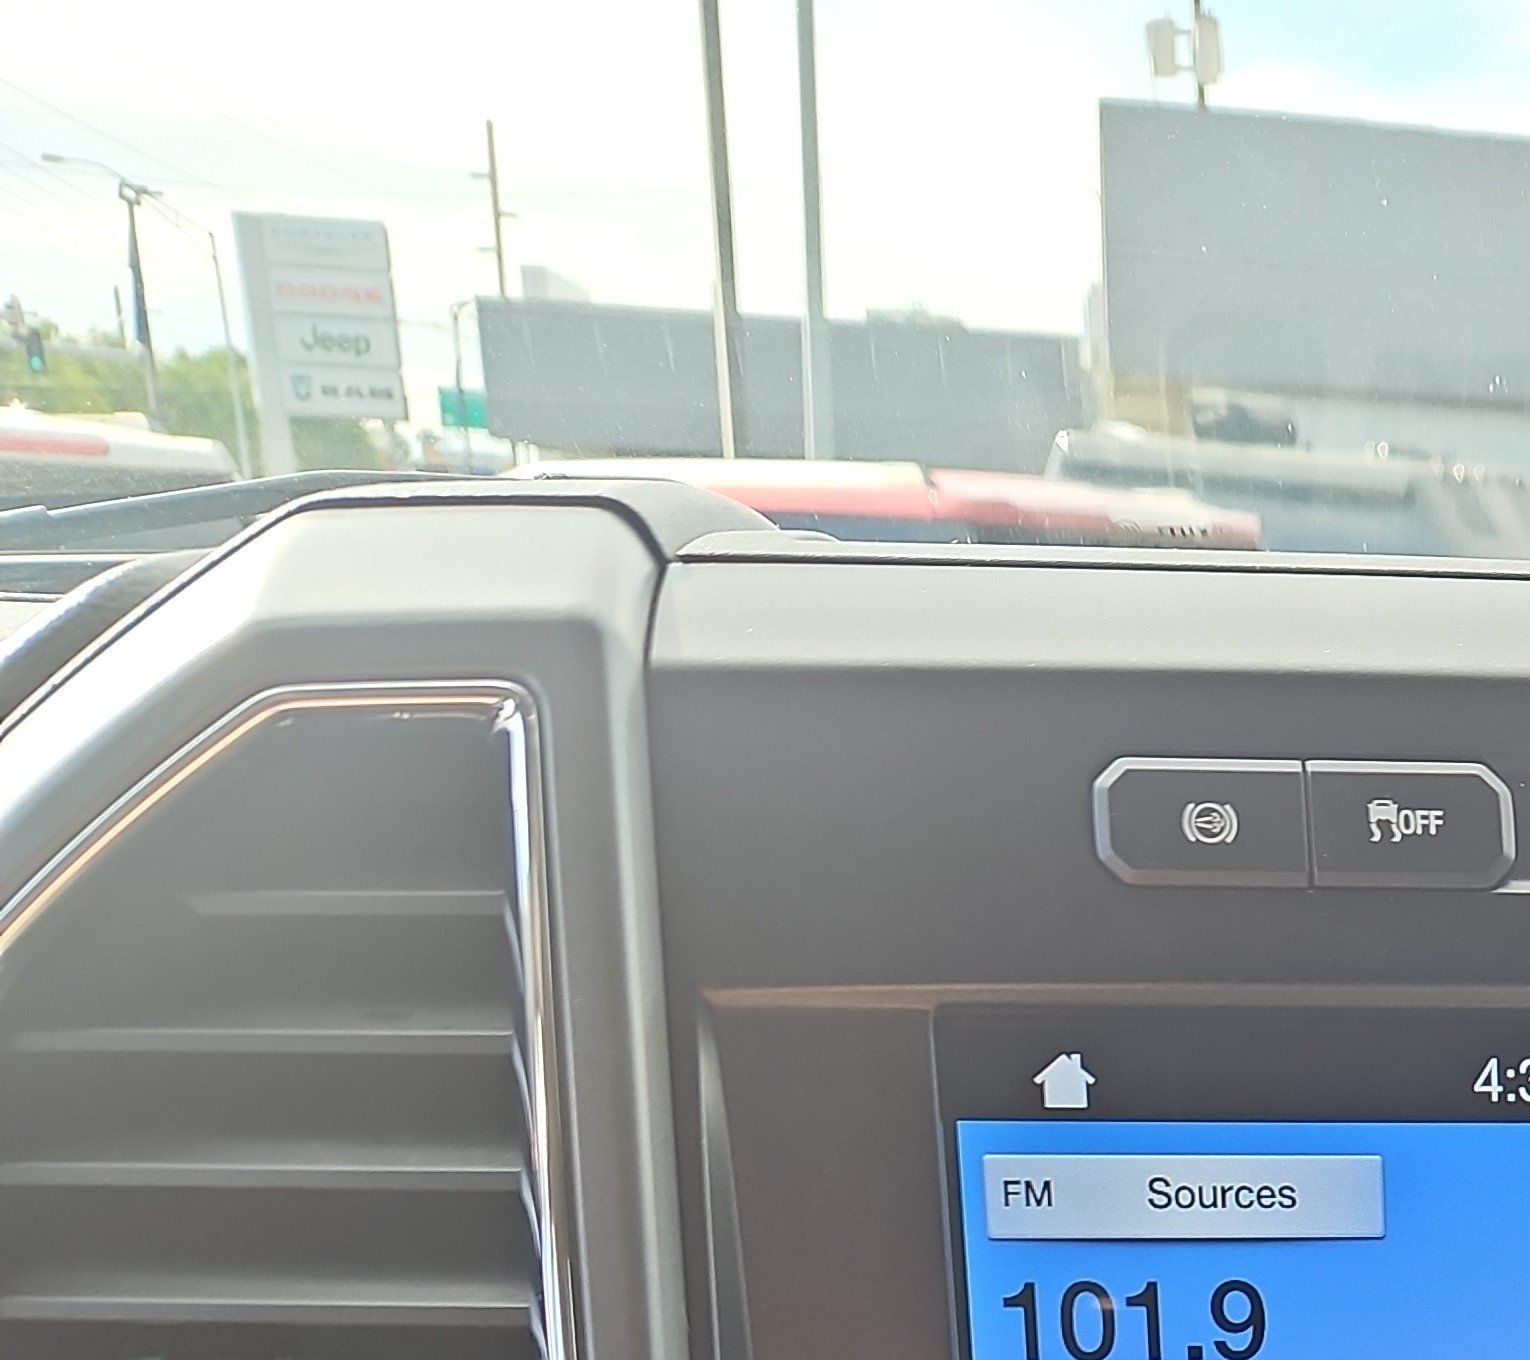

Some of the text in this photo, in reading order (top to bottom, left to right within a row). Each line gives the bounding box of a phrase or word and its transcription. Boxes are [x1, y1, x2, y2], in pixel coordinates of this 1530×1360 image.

[299, 322, 371, 357] Jeep
[1401, 808, 1444, 834] OFF
[1003, 1181, 1053, 1207] FM
[1147, 1178, 1297, 1209] Sources
